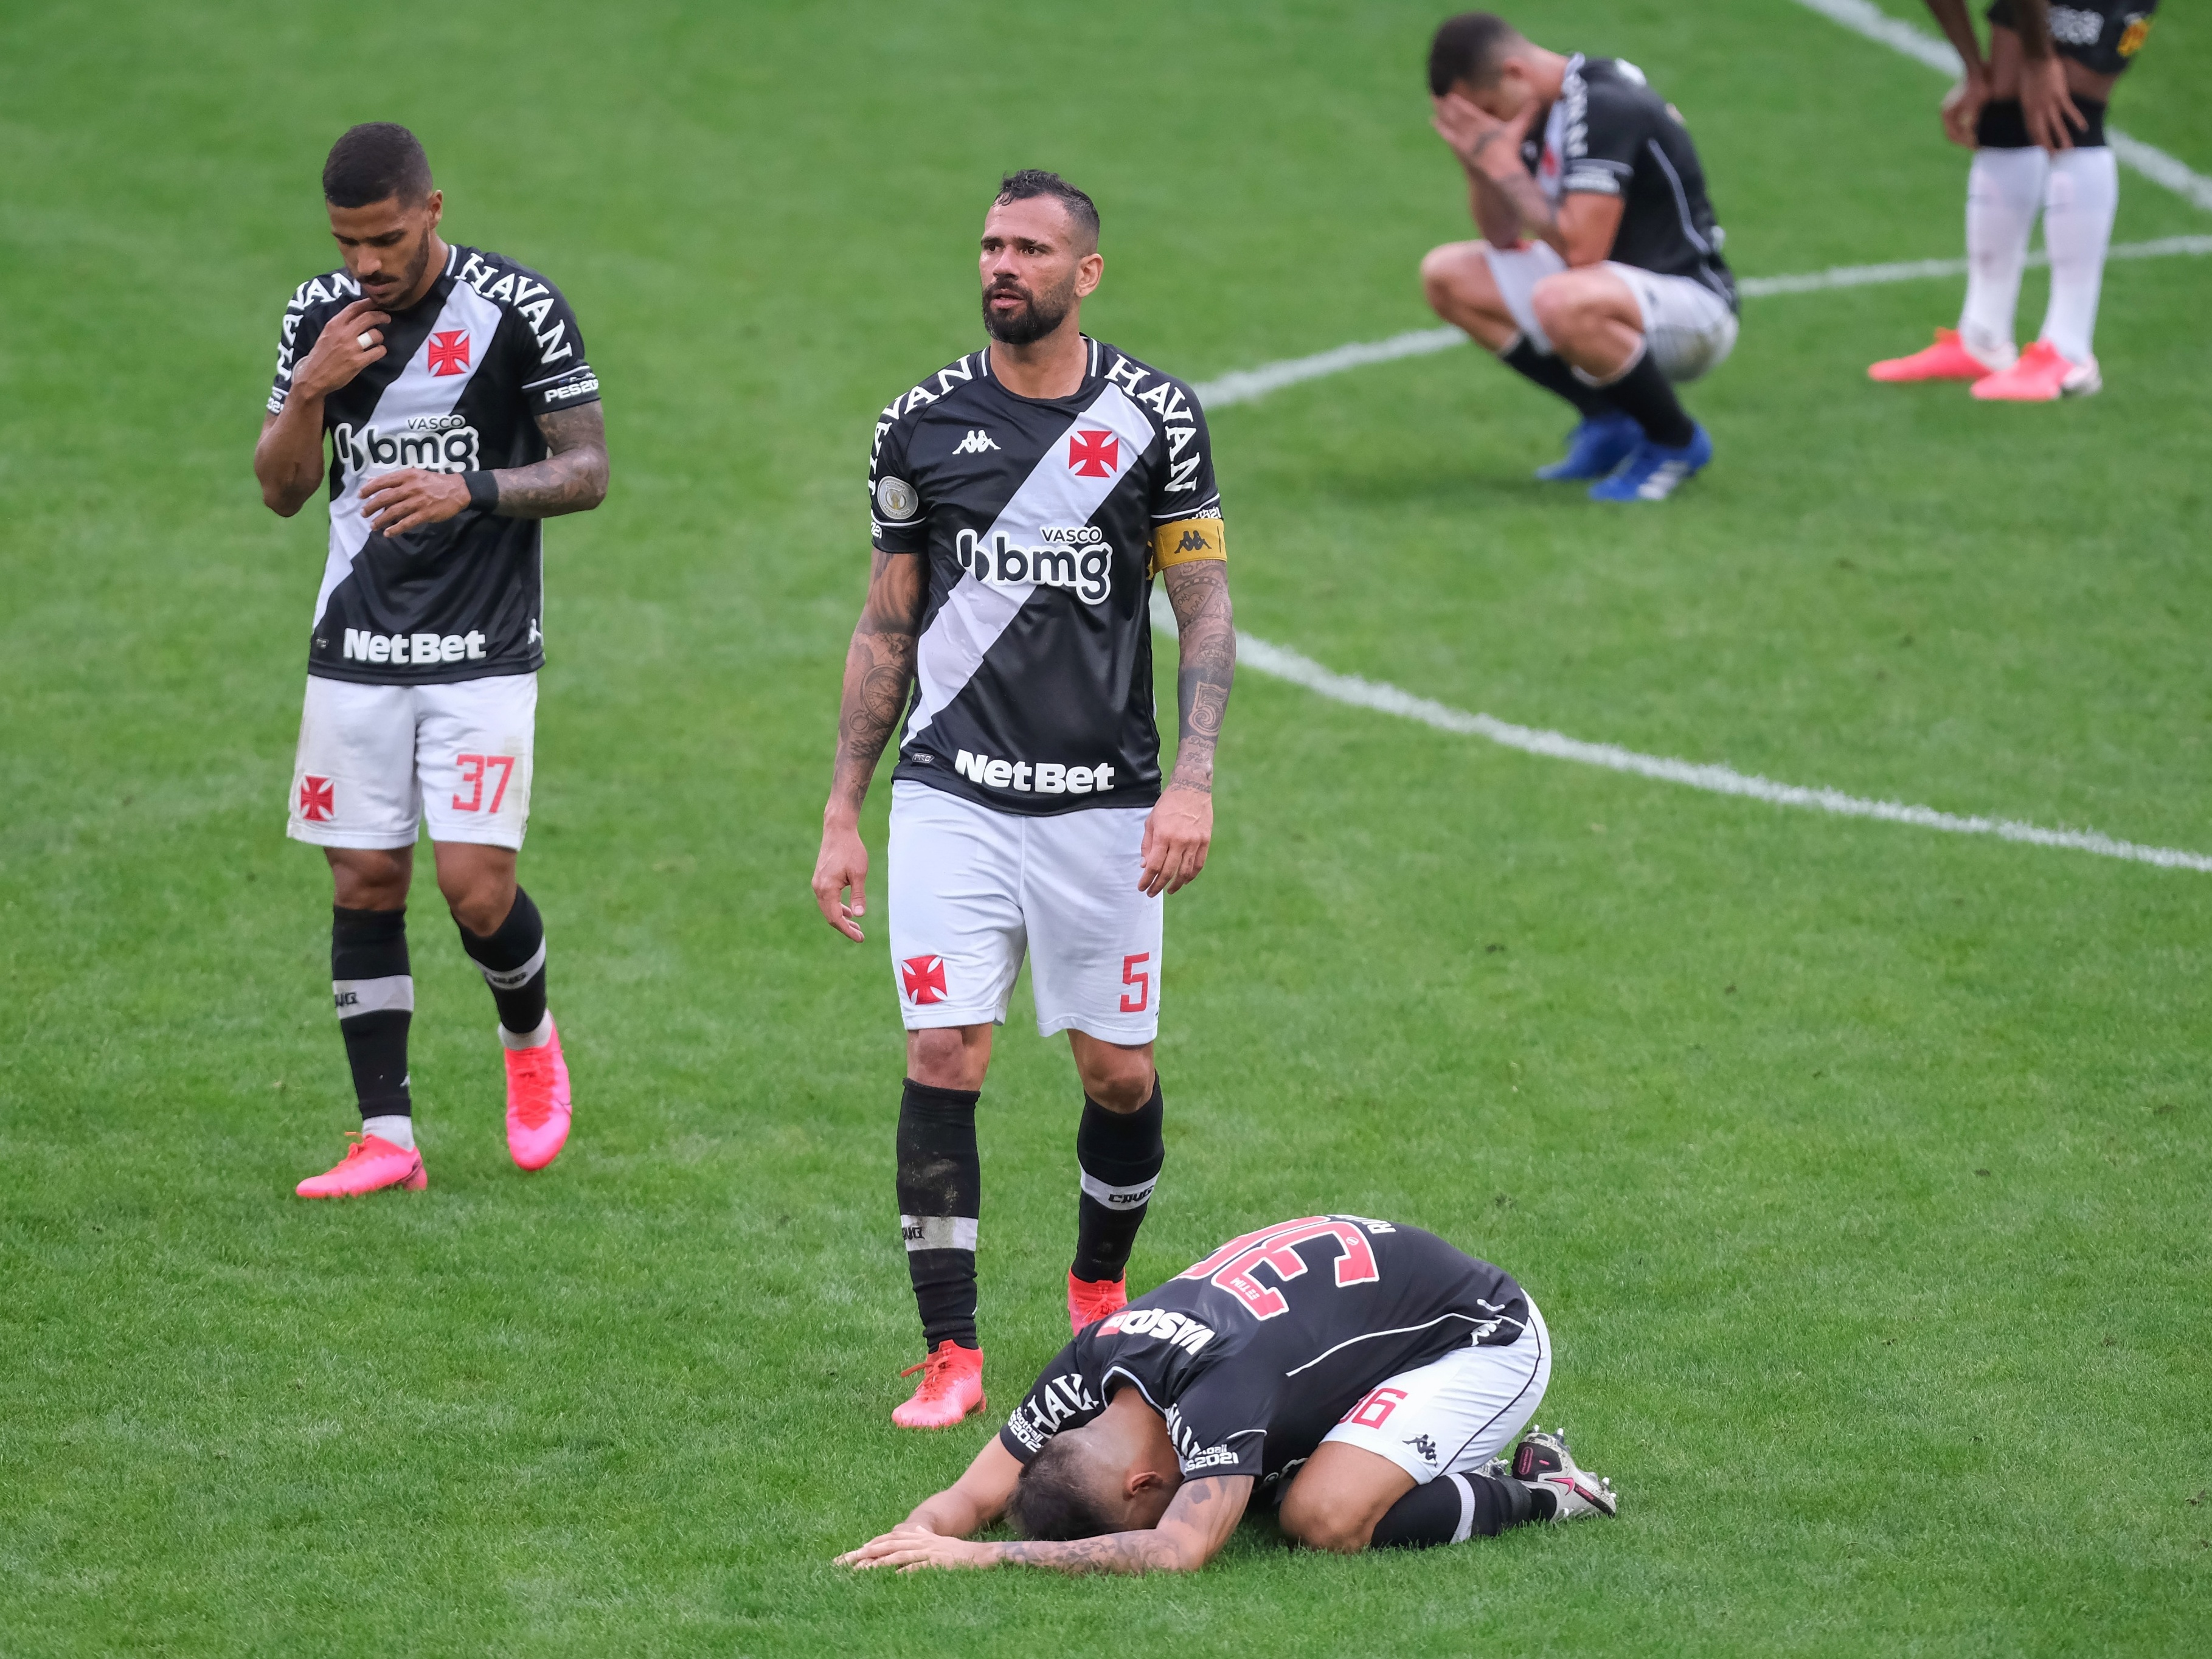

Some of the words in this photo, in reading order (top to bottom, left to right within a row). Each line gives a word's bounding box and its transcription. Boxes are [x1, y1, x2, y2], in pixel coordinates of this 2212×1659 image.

[454, 252, 572, 364] HAVAN
[407, 417, 462, 430] VASCO
[1104, 354, 1200, 492] HAVAN
[367, 428, 474, 474] bmg
[1041, 528, 1101, 542] VASCO
[996, 536, 1109, 600] bmg
[343, 628, 487, 665] NetBet
[452, 754, 515, 814] 37
[955, 749, 1115, 794] NetBet
[1120, 952, 1149, 1013] 5
[1338, 1387, 1409, 1430] 6
